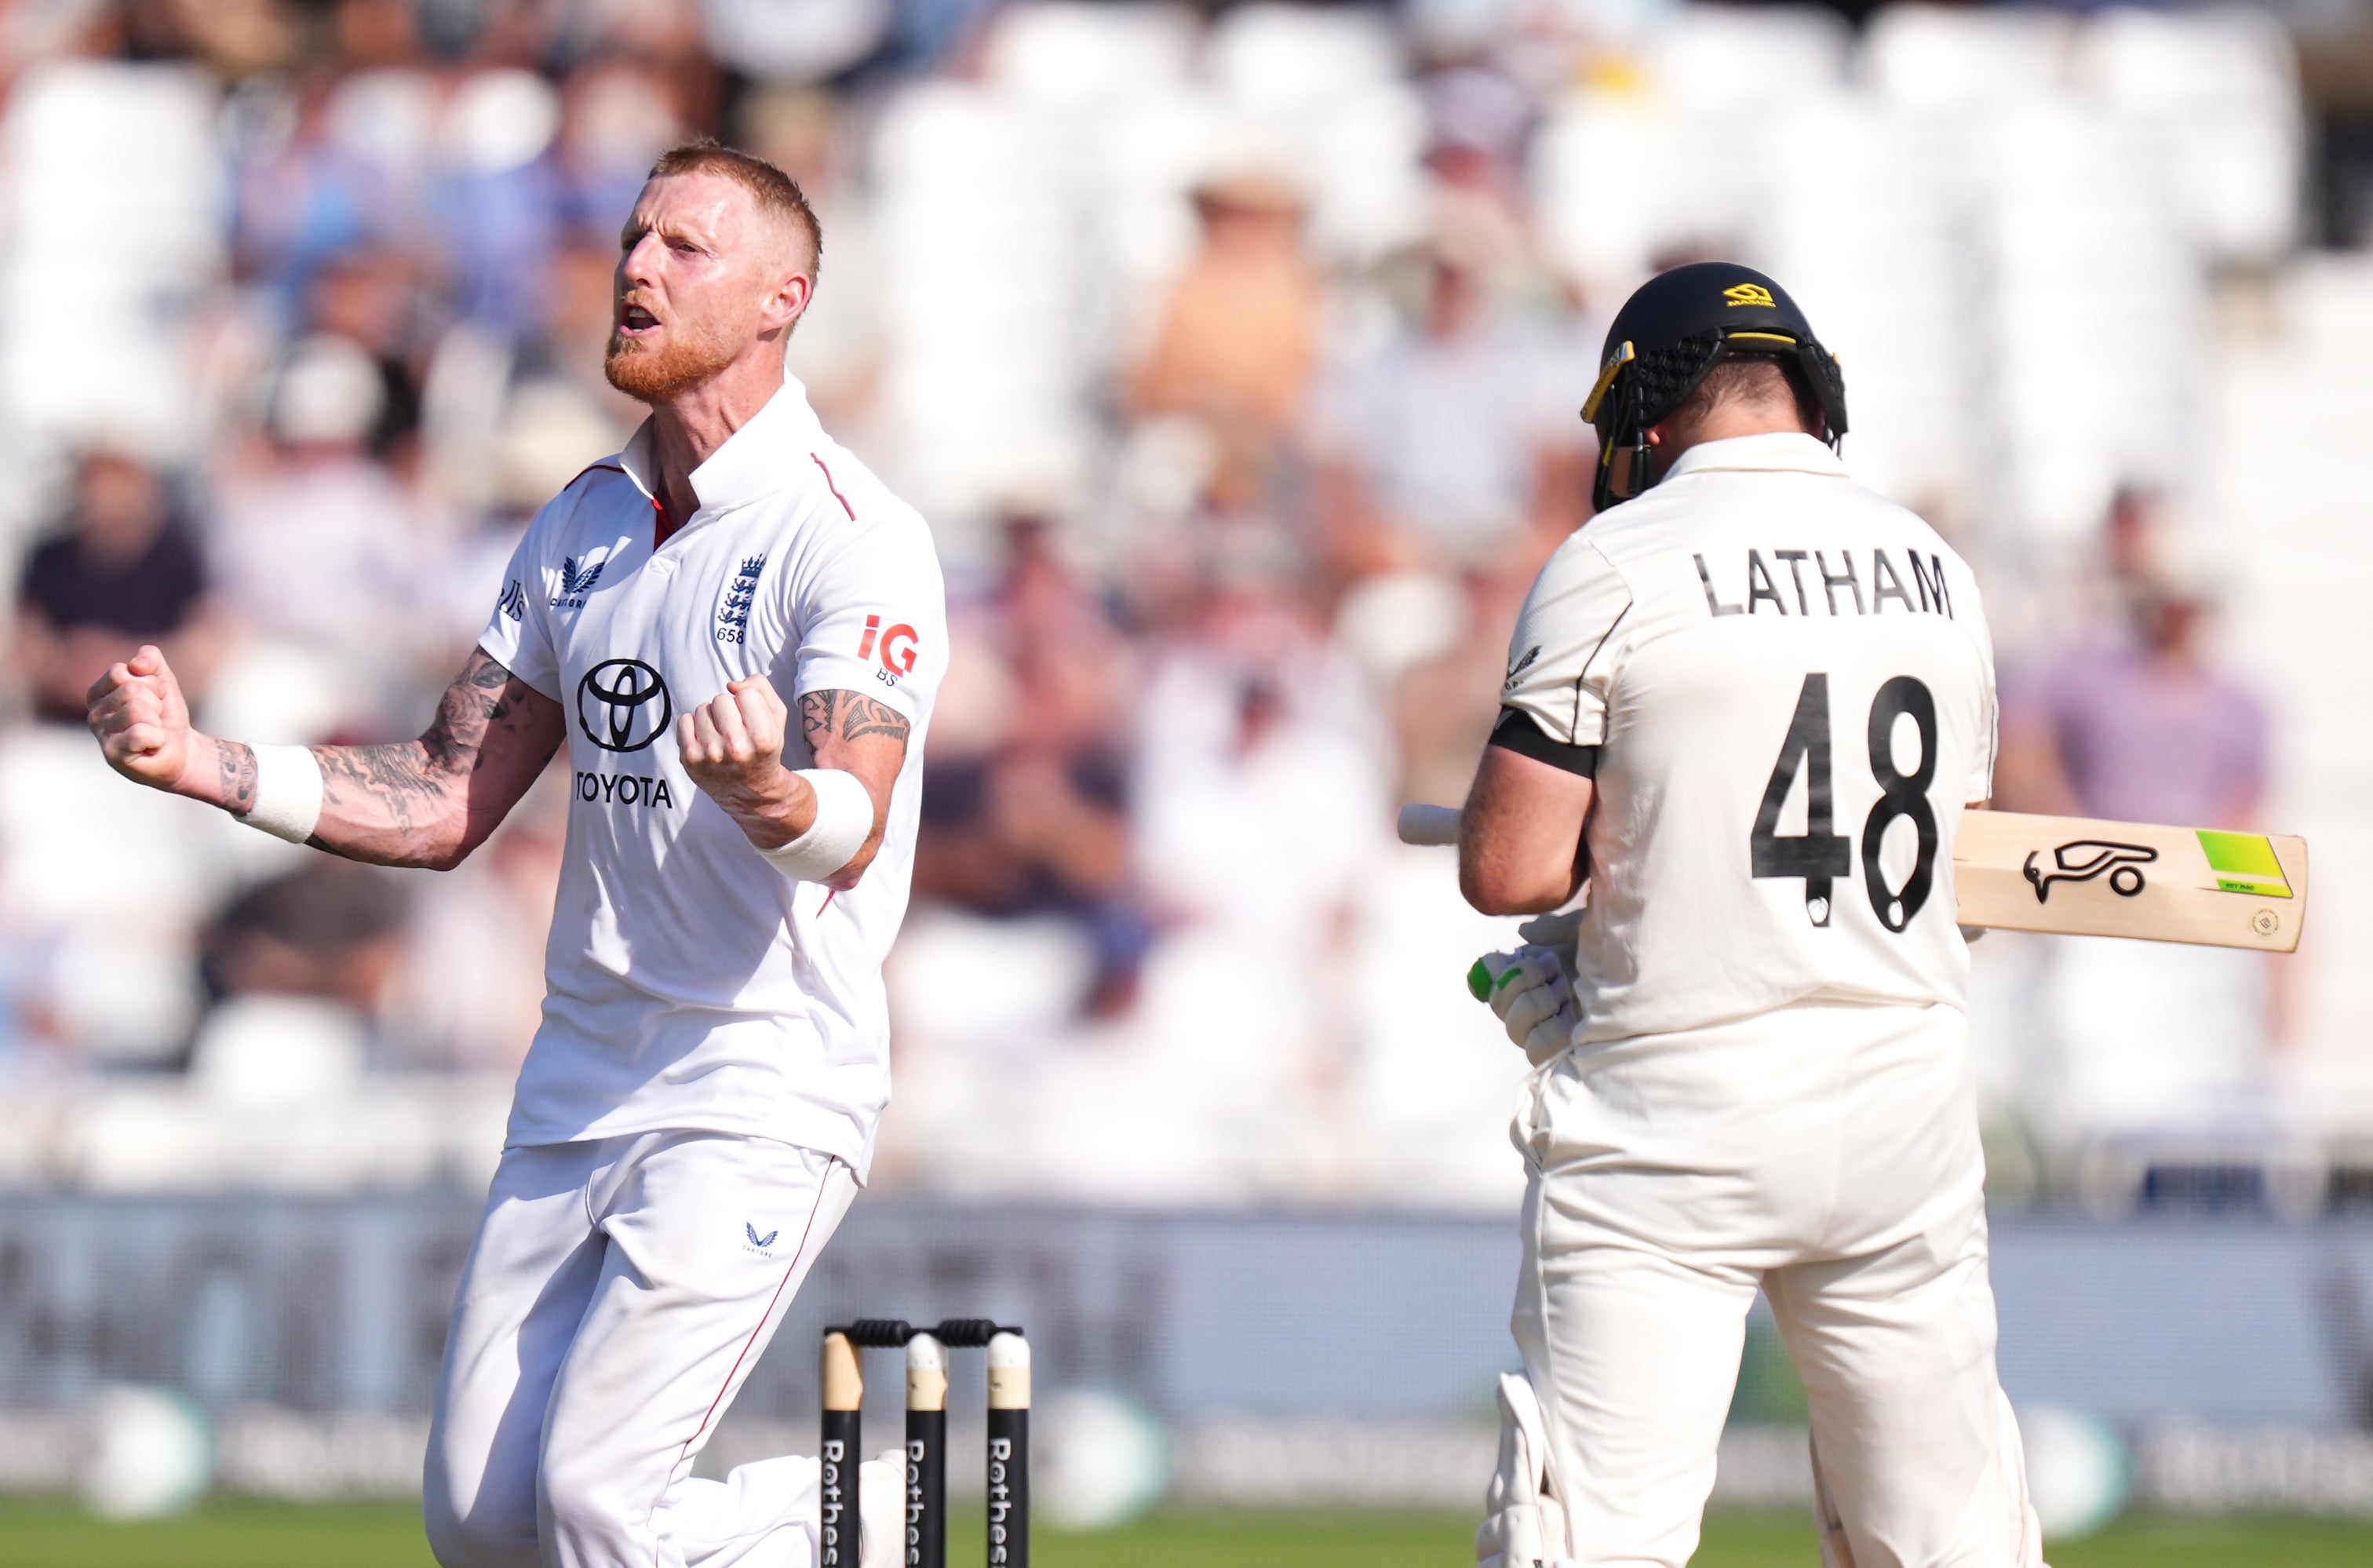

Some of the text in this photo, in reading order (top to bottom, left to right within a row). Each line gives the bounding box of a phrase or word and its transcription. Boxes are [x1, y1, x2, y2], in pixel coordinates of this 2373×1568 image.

[1693, 548, 1954, 620] LATHAM
[716, 627, 745, 644] 658
[877, 667, 898, 687] BS
[576, 772, 673, 809] TOYOTA
[1751, 673, 1938, 934] 48
[822, 1439, 845, 1567] Rothes
[907, 1439, 925, 1567] Rothes
[988, 1437, 1012, 1568] Rothes
